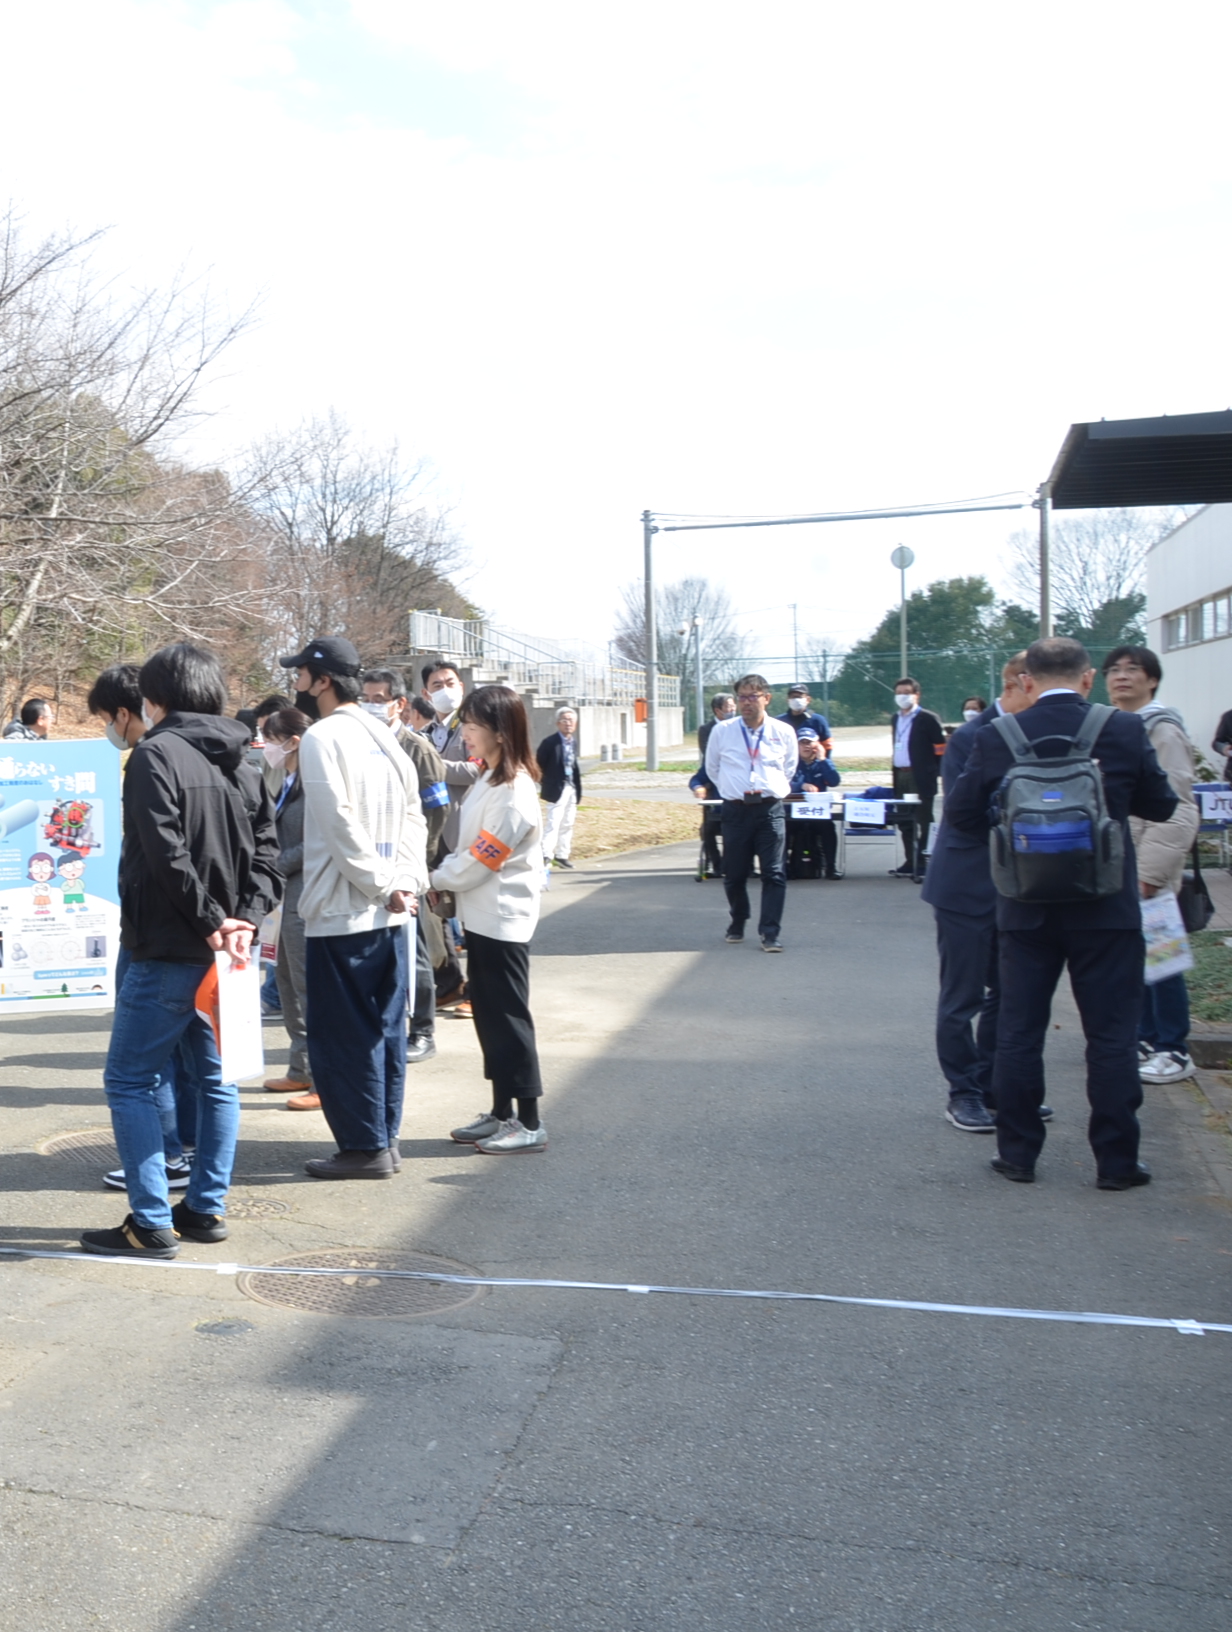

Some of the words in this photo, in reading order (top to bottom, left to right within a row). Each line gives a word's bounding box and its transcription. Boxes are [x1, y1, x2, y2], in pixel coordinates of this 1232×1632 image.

[48, 771, 96, 794] すき間
[797, 806, 824, 816] 受付
